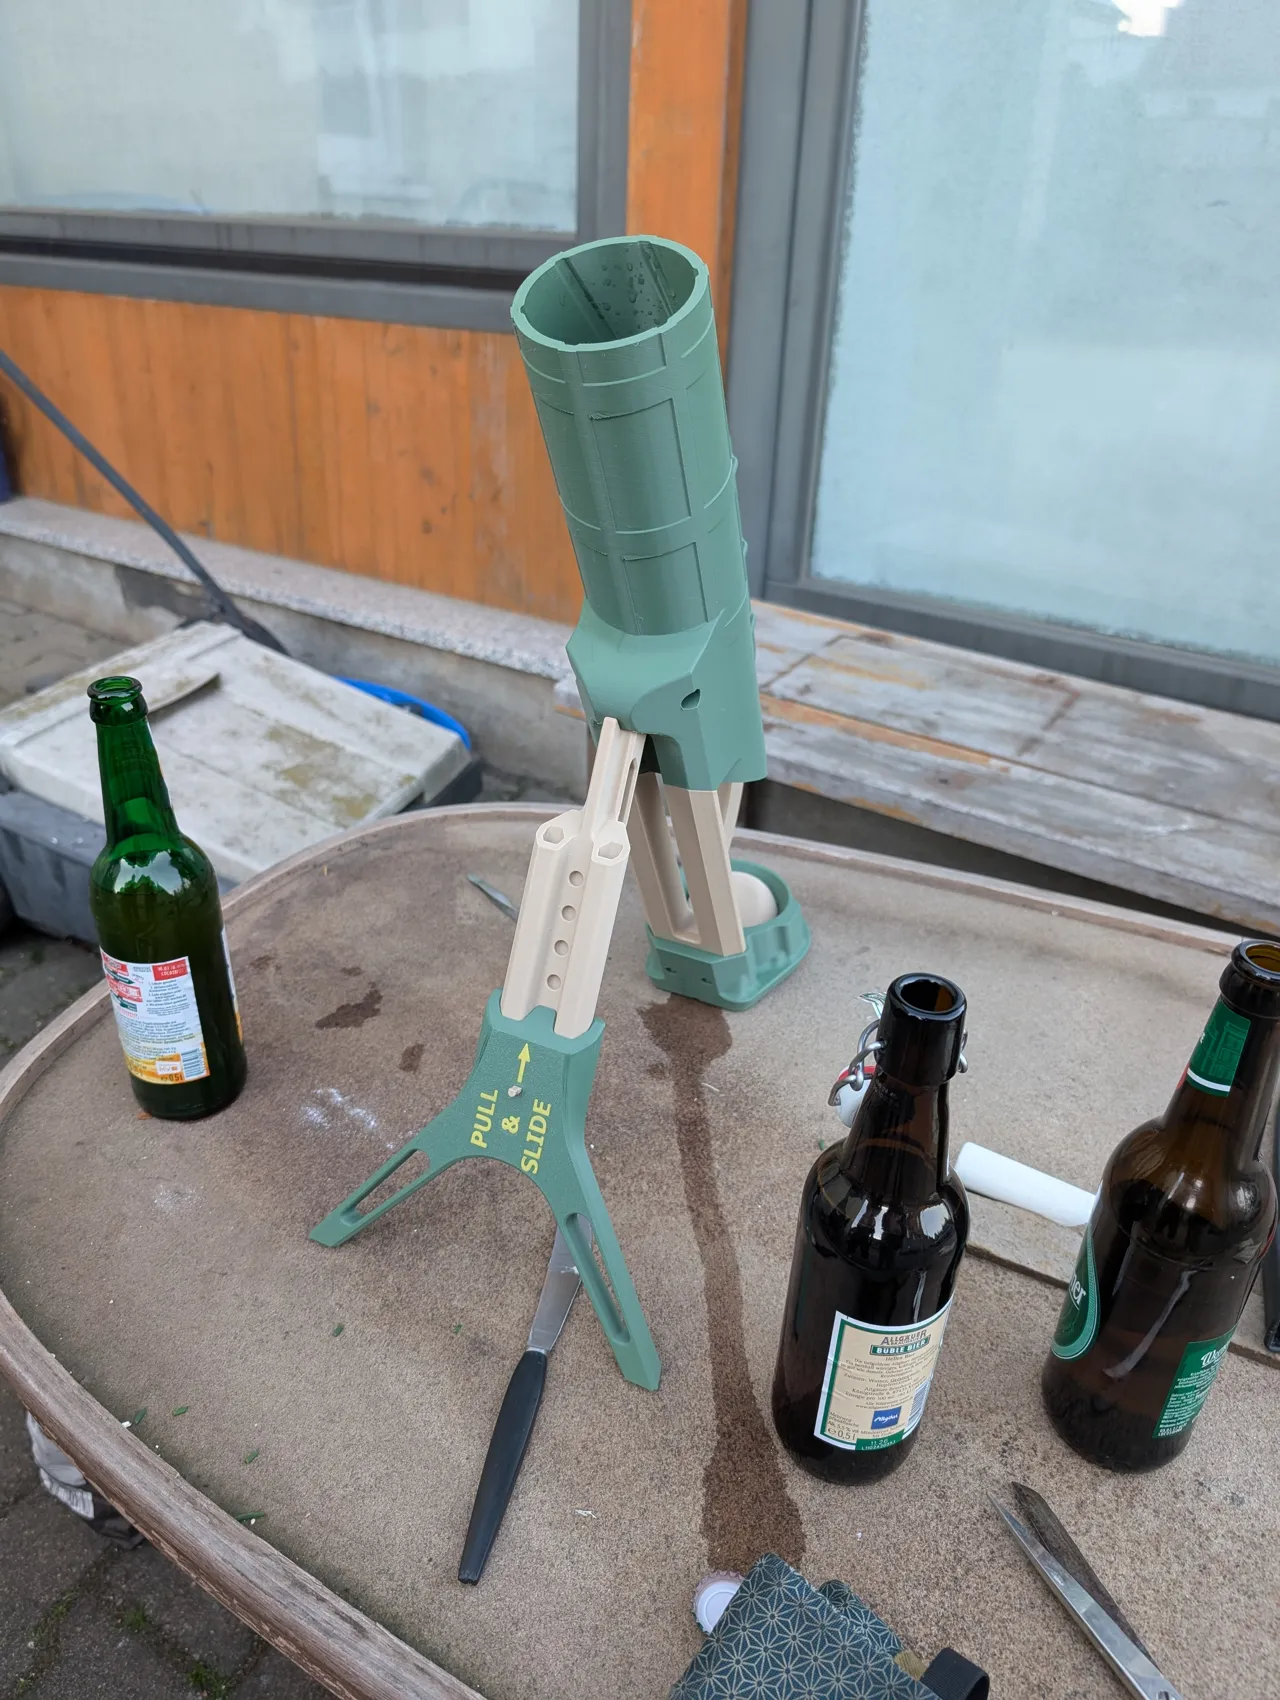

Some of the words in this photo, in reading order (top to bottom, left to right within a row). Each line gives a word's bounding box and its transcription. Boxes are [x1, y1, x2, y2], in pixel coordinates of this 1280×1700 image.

[470, 1089, 499, 1149] PULL
[501, 1115, 521, 1134] &
[520, 1099, 552, 1175] SLIDE
[907, 1339, 926, 1351] BIER
